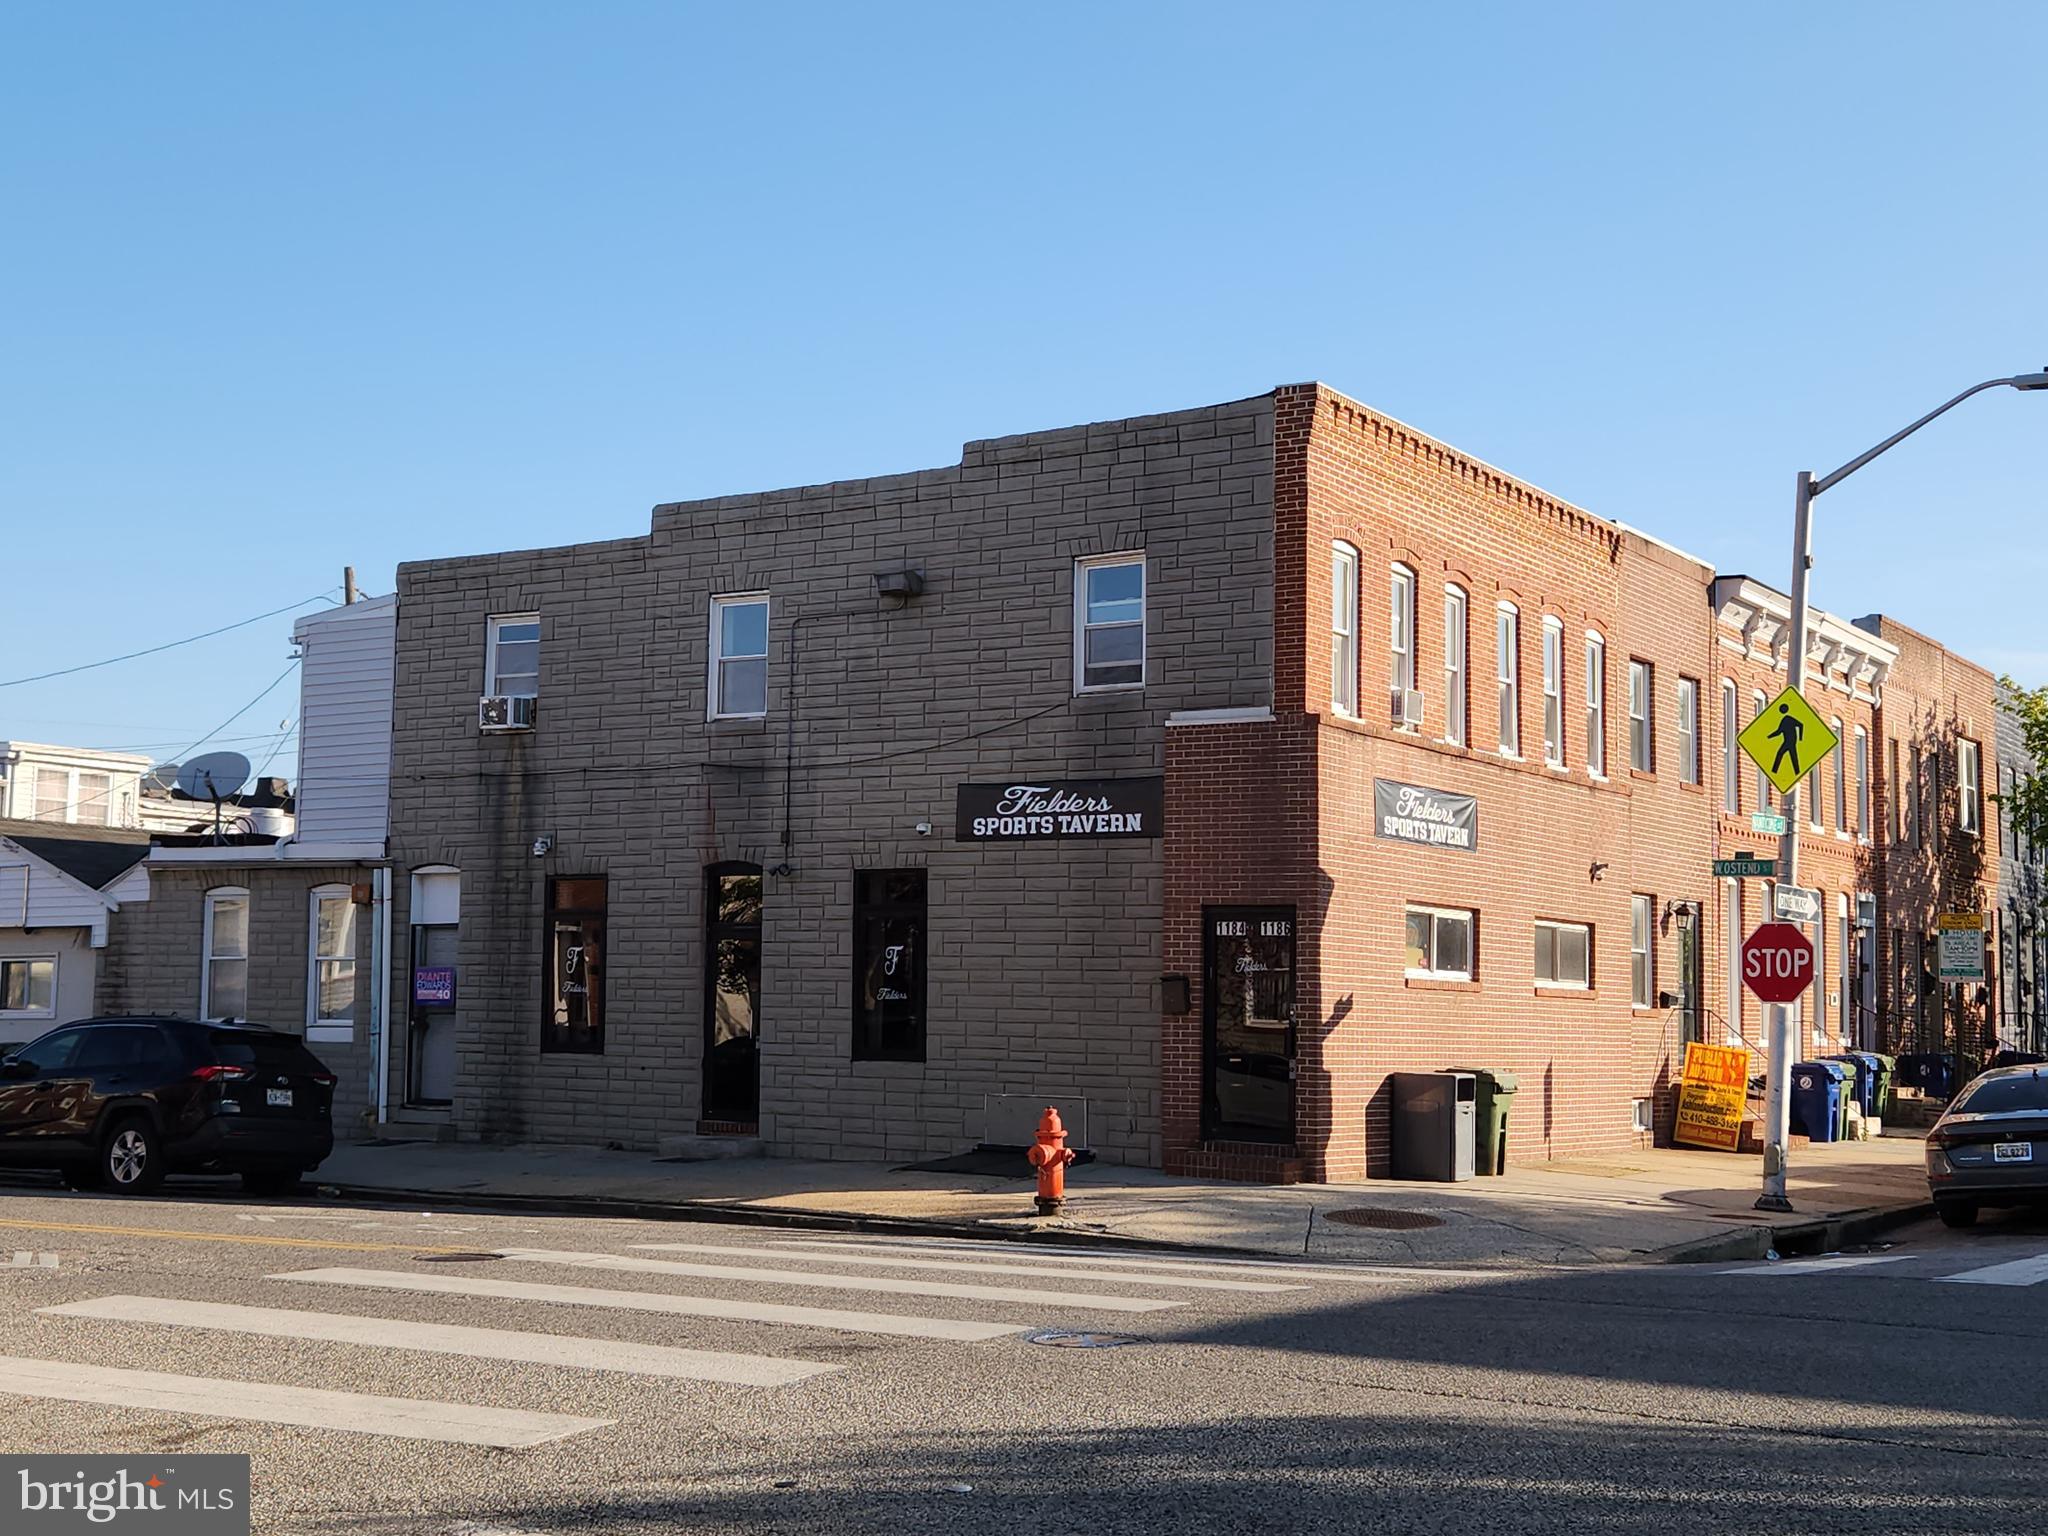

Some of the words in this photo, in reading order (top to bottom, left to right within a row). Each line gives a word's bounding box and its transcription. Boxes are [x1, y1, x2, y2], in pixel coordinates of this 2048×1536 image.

[996, 785, 1113, 815] Fielders
[1396, 787, 1456, 825] Fielders
[973, 815, 1054, 836] SPORTS
[1057, 813, 1142, 834] TAVERN
[1384, 815, 1427, 840] SPORTS
[1428, 822, 1469, 847] TAVERN
[1724, 862, 1760, 875] OSTEND
[1779, 895, 1793, 909] ONE
[1794, 898, 1808, 912] WAY
[1217, 921, 1246, 936] 1184
[1261, 921, 1291, 936] 1186
[566, 946, 584, 974] F
[884, 945, 904, 975] F
[1745, 947, 1810, 978] STOP
[416, 972, 450, 983] DIANTE
[416, 980, 451, 990] EDWARDS
[436, 989, 450, 1000] 40
[1693, 1047, 1724, 1066] PUBLIC
[1687, 1064, 1723, 1082] AUCTION
